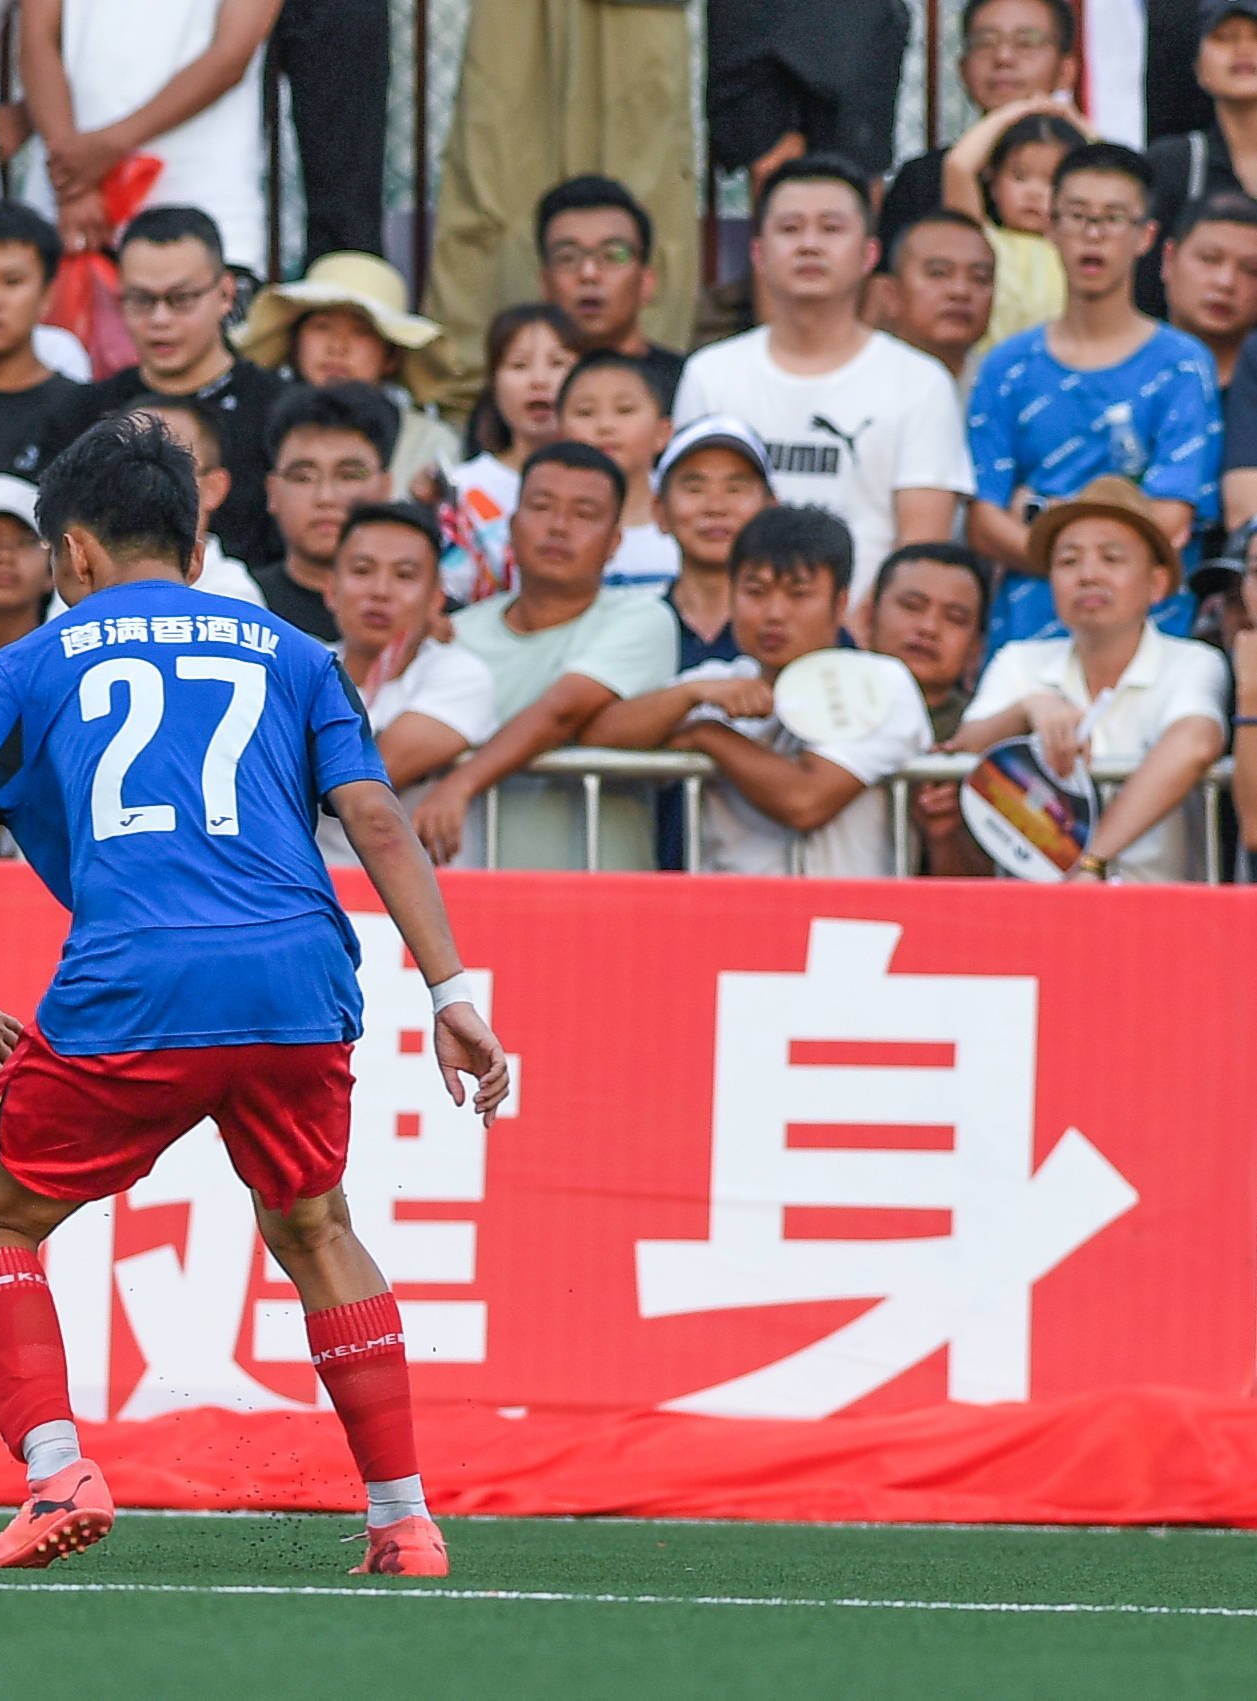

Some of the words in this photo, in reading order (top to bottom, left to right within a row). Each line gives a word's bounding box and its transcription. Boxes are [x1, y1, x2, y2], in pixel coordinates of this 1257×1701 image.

[764, 442, 839, 474] UMA
[79, 656, 267, 841] 27
[320, 1332, 398, 1362] KELME
